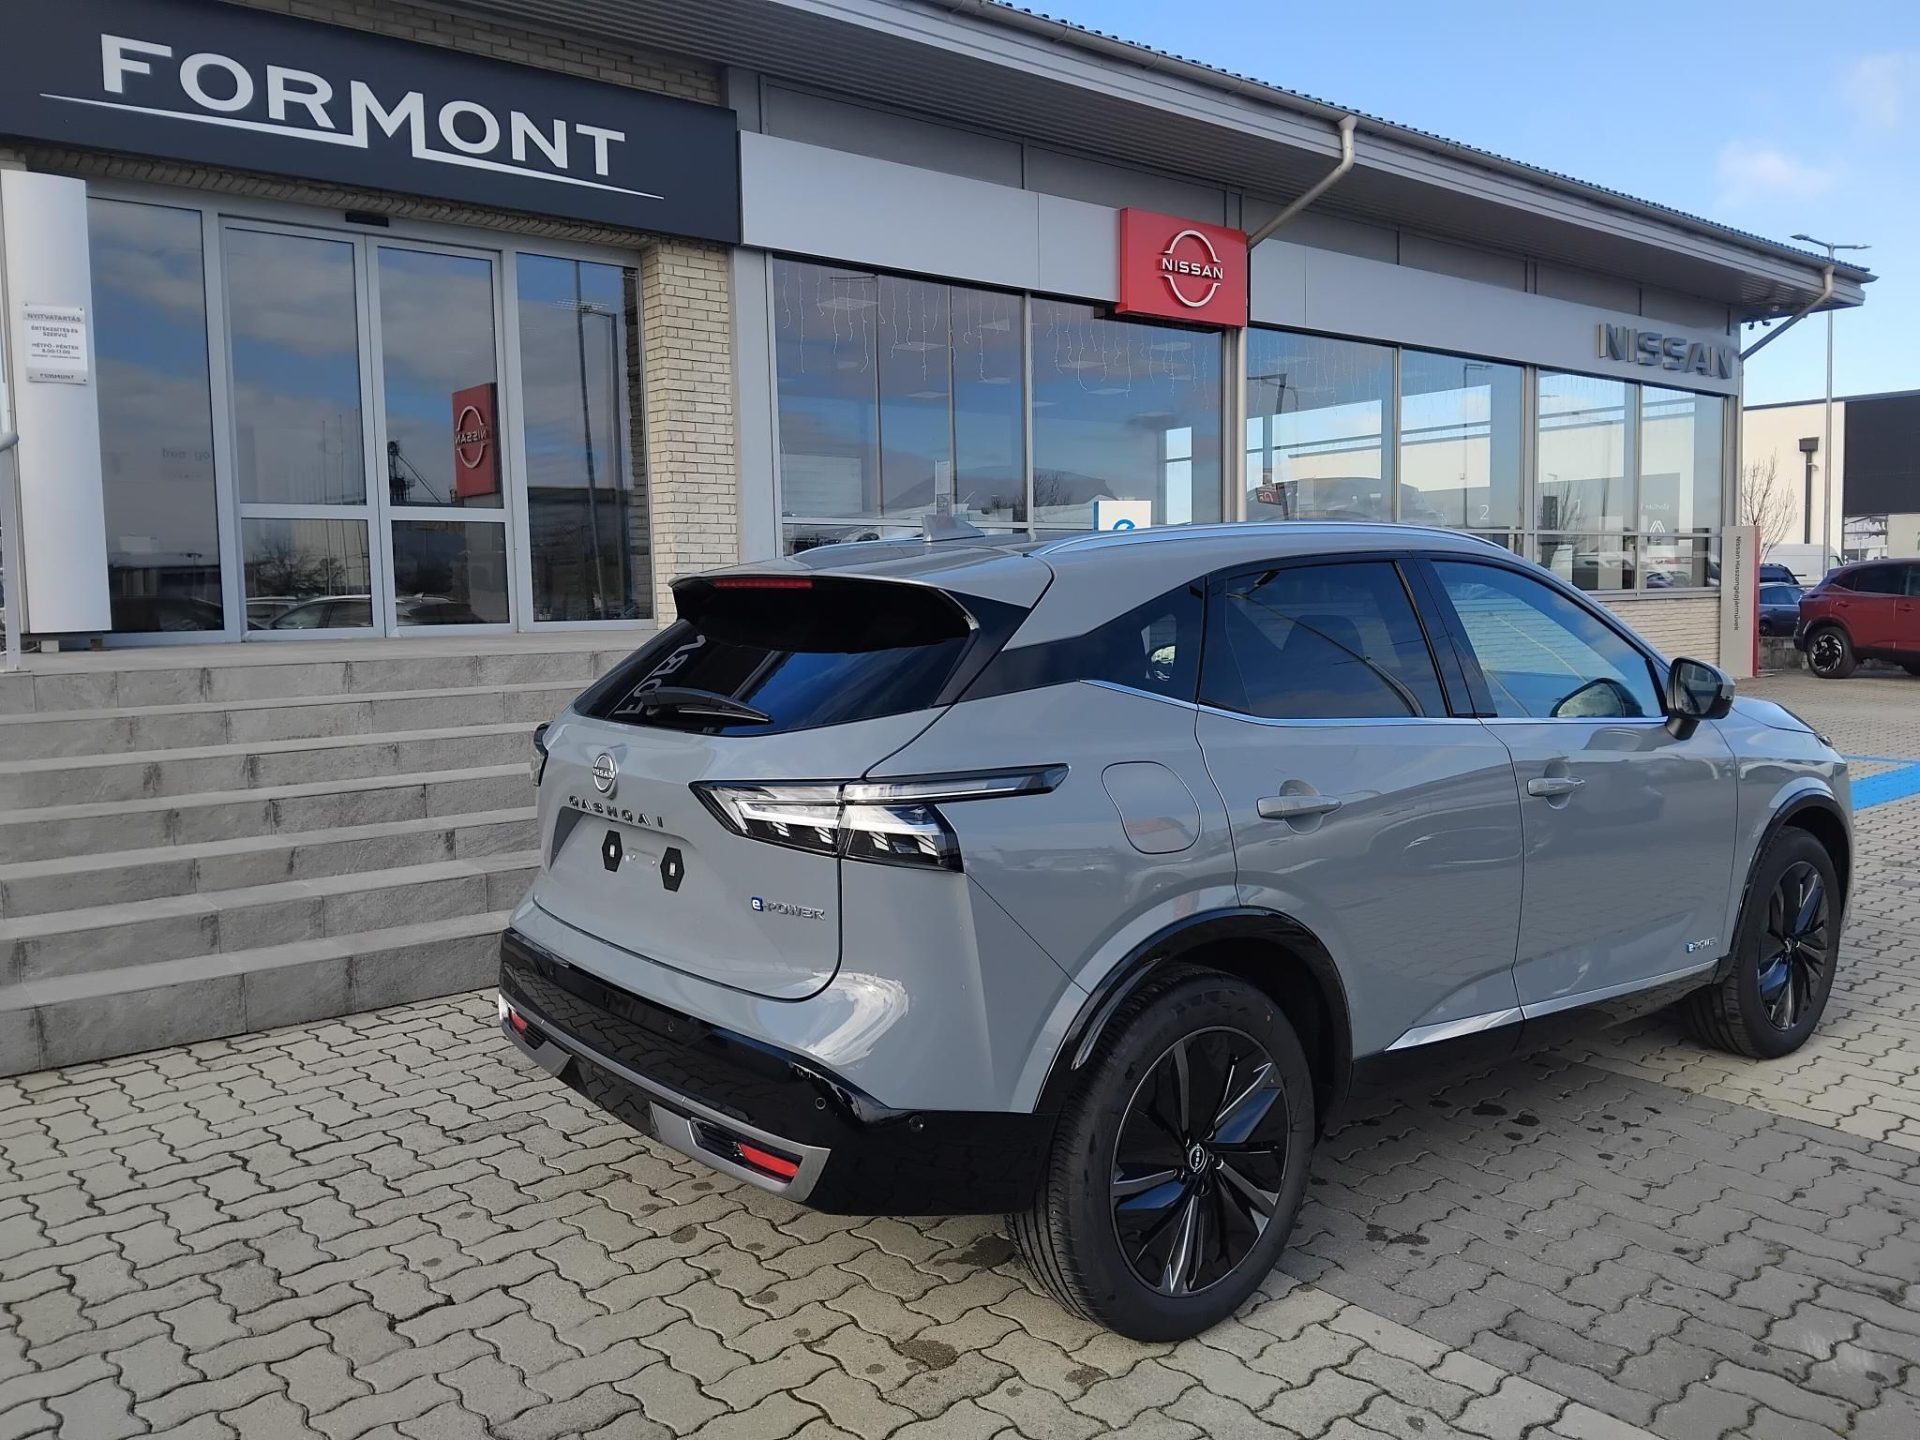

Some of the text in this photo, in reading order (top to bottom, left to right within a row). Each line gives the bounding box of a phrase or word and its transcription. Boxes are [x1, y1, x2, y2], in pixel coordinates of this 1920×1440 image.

[101, 34, 627, 177] FORMONT
[1162, 257, 1223, 280] NISSAN
[27, 312, 81, 322] NYITVATARTÁS
[1595, 322, 1733, 380] NISSAN
[1479, 504, 1490, 520] 2
[568, 795, 664, 828] QASHQAI
[751, 896, 826, 921] e-POWER
